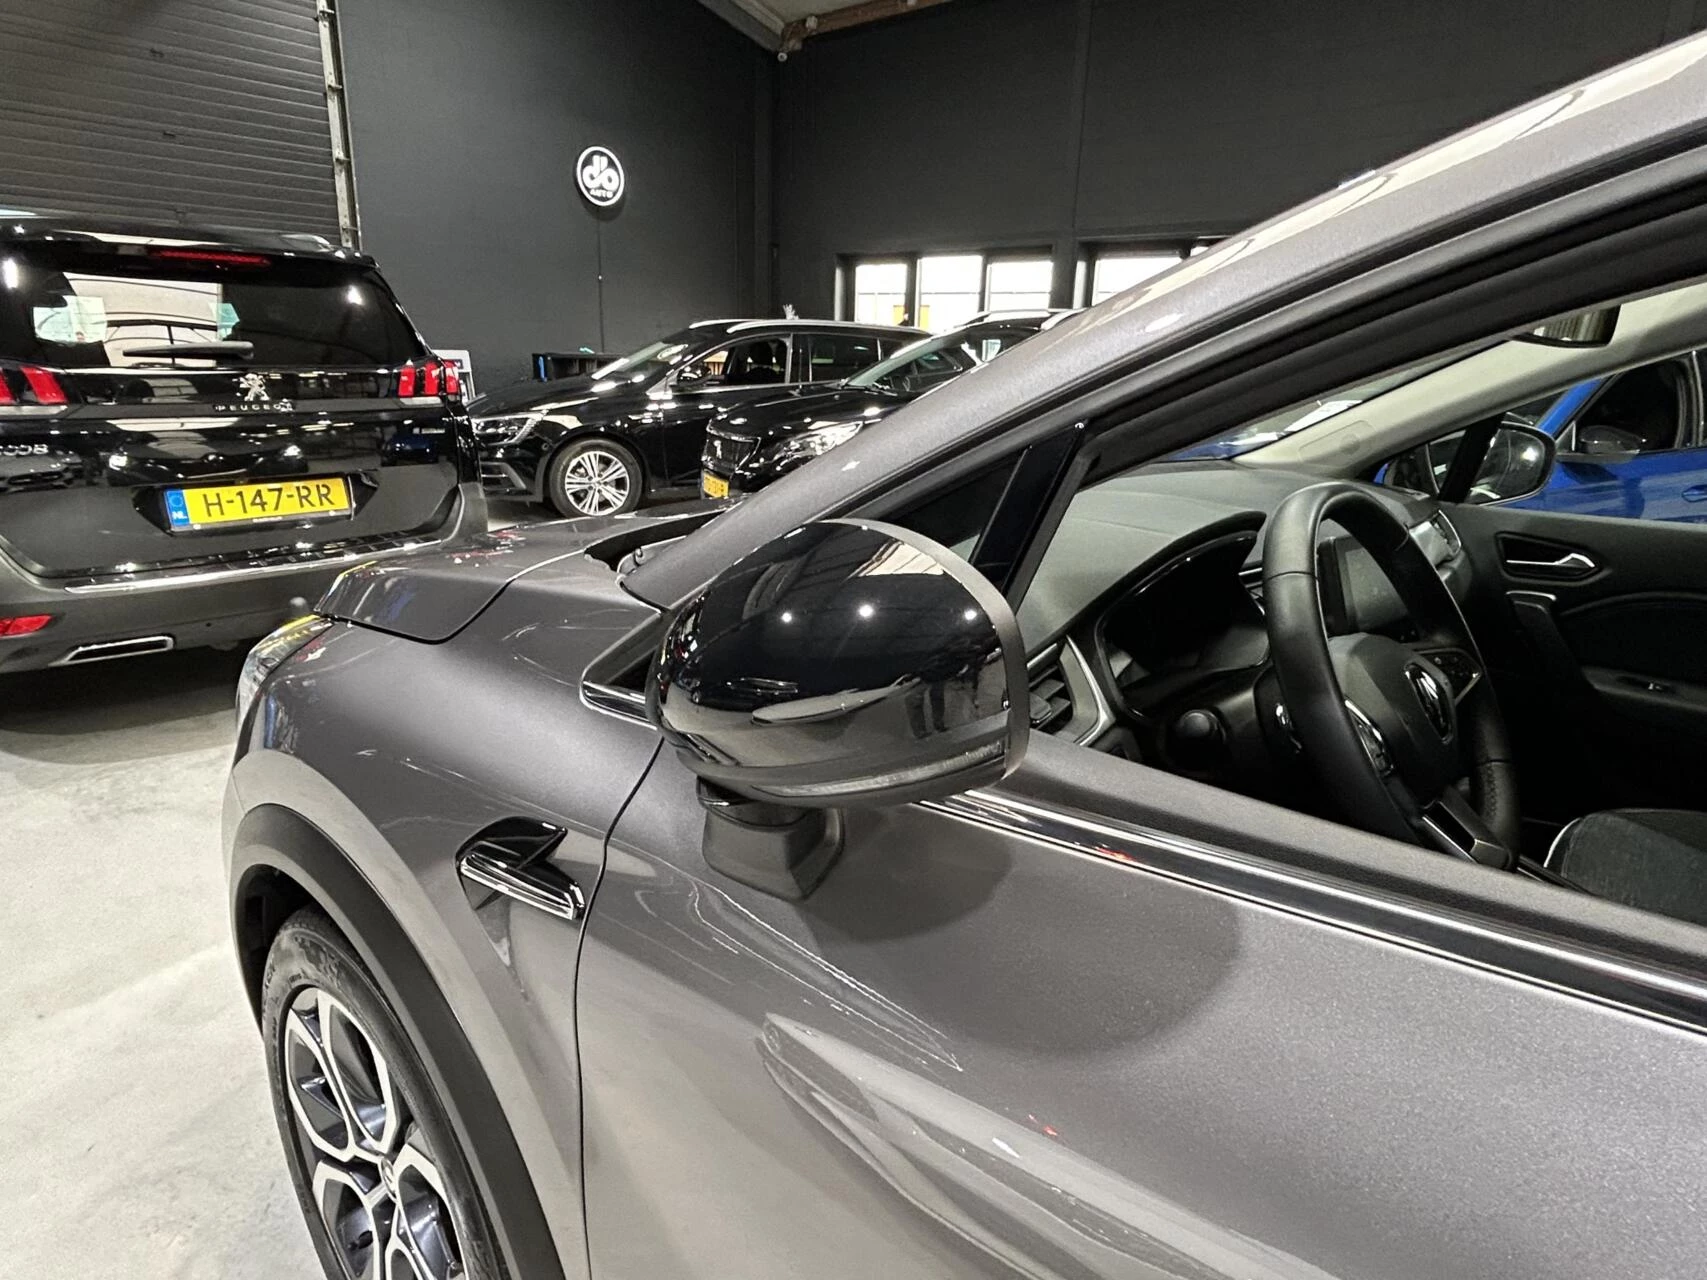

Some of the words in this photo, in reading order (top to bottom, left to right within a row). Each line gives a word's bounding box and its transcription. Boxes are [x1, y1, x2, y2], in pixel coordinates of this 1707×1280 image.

[0, 443, 49, 456] 008
[202, 483, 335, 518] H-147-RR
[172, 510, 188, 519] NL
